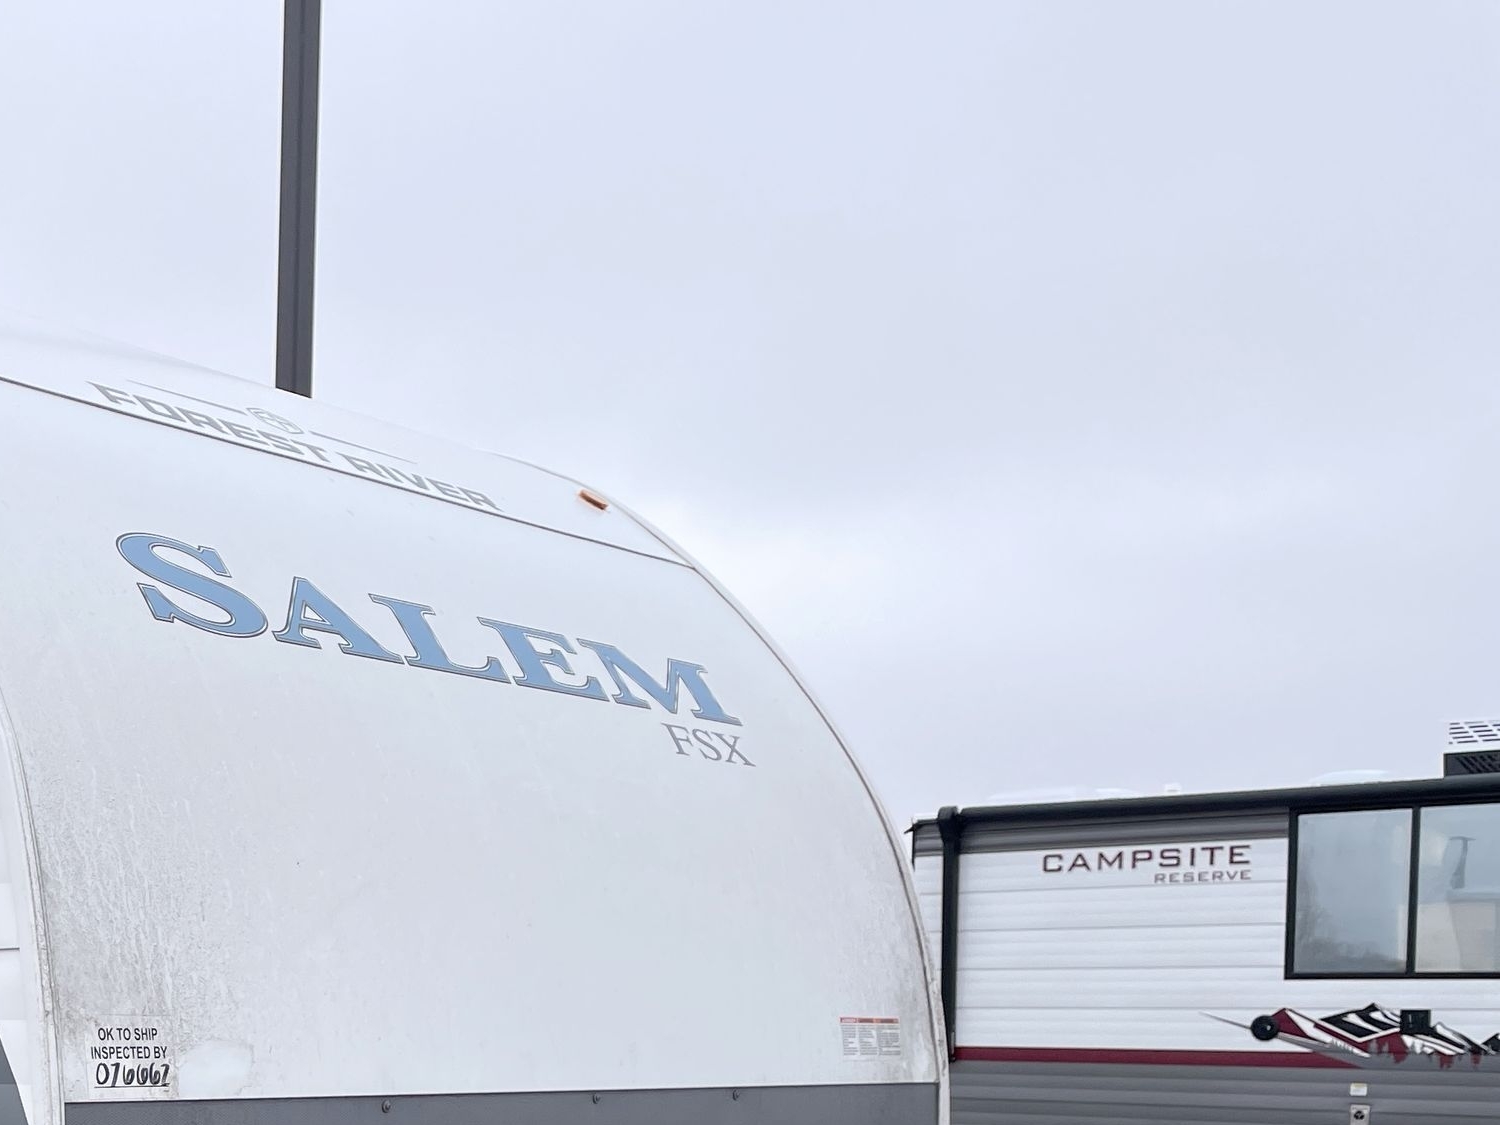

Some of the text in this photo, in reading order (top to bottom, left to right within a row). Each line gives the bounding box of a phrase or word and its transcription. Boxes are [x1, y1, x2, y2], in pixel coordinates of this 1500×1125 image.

[84, 380, 503, 513] FOREST RIVER
[114, 531, 744, 727] SALEM
[660, 722, 757, 768] FSX
[1042, 845, 1251, 873] CAMPSITE
[1153, 870, 1252, 884] RESERVE
[97, 1027, 158, 1041] OK TO SHIP
[90, 1045, 168, 1059] INSPECTED BY
